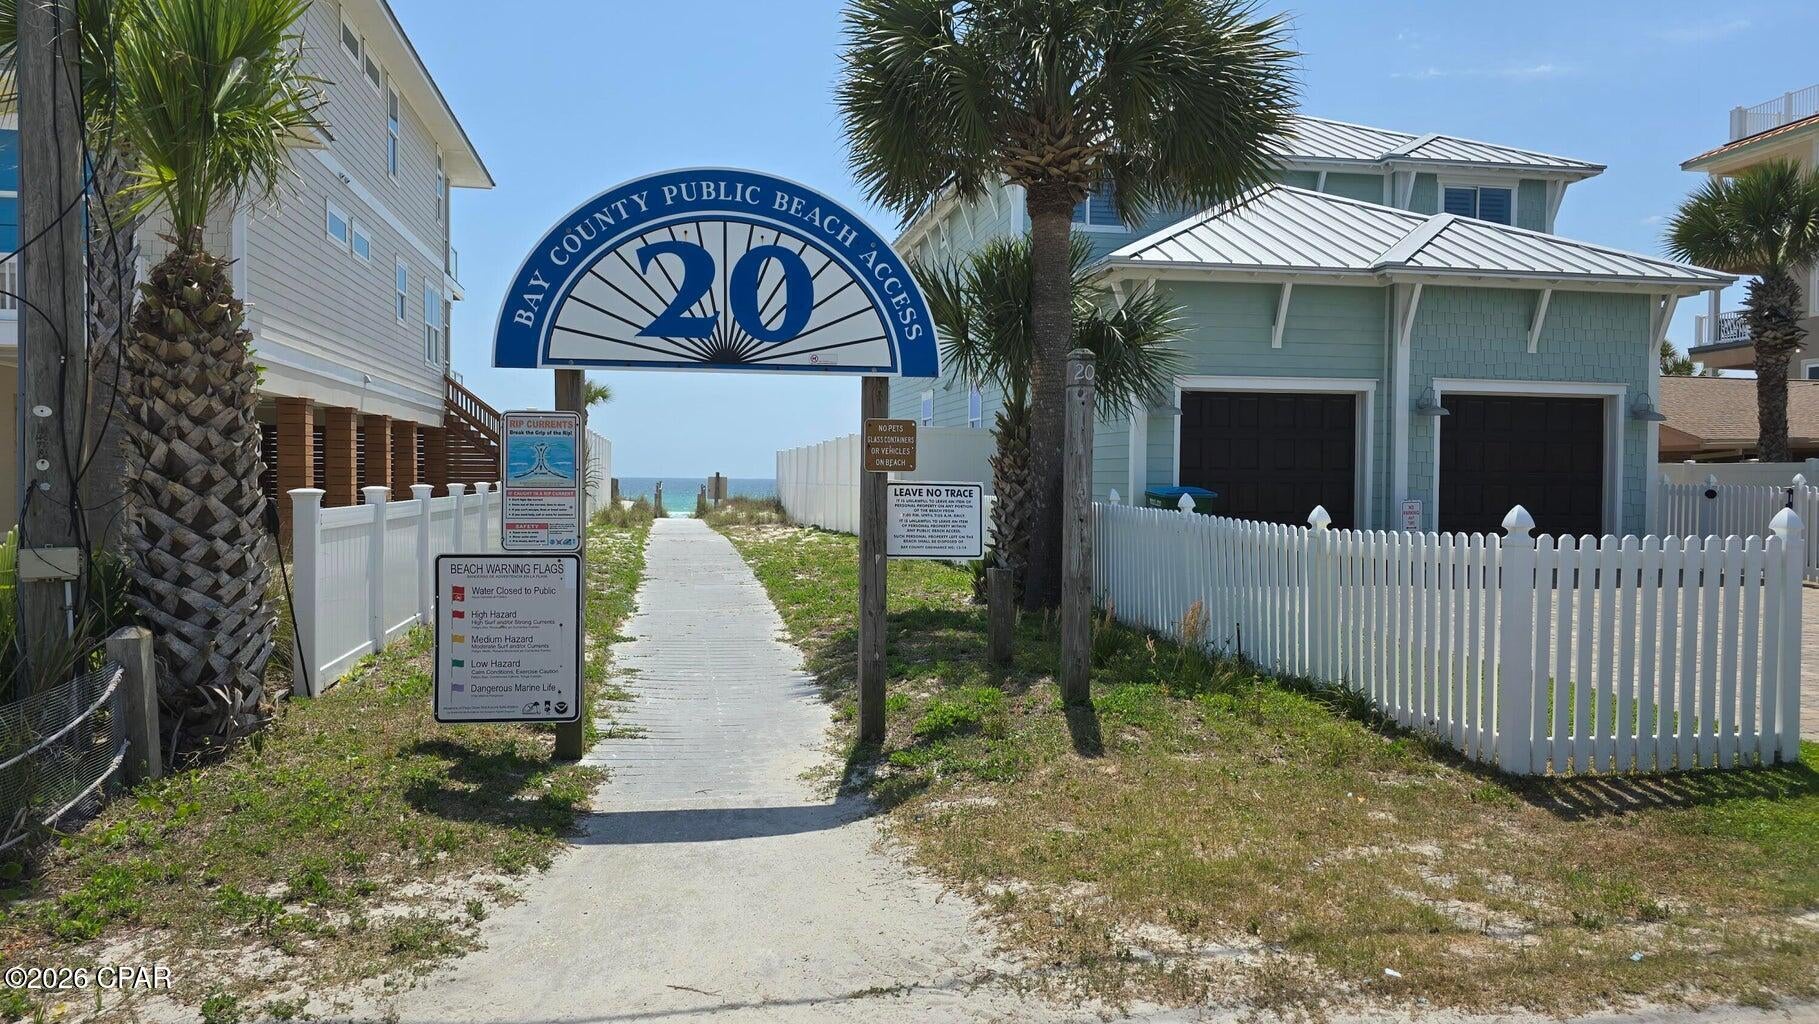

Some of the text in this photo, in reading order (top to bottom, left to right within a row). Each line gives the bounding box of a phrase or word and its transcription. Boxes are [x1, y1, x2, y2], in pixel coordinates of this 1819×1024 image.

[514, 181, 922, 340] BAY COUNTY PUBLIC BEACH ACCESS
[634, 240, 814, 342] 20
[1074, 364, 1095, 380] 20
[510, 420, 574, 428] RIP CURRENTS
[894, 488, 973, 497] LEAVE NO TRACE
[450, 564, 564, 574] BEACH WARNING FLAGS
[472, 611, 487, 619] High
[471, 685, 512, 694] Dangerous
